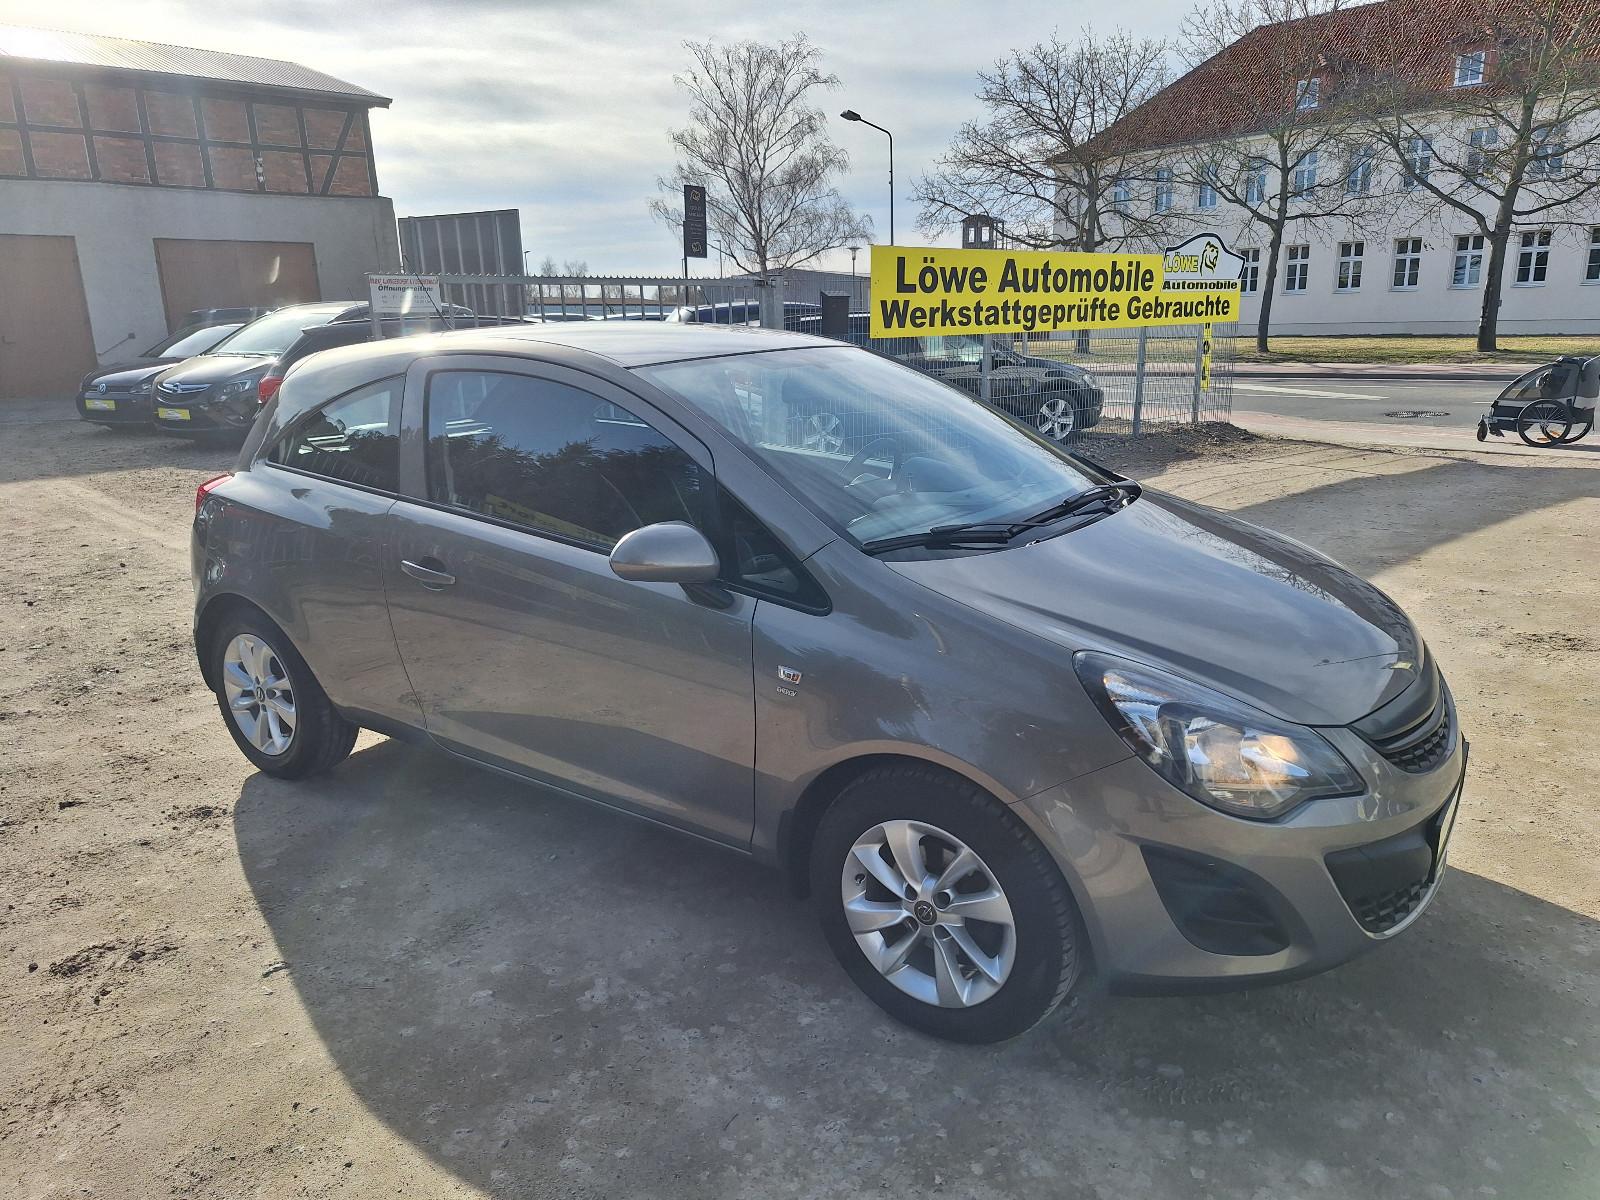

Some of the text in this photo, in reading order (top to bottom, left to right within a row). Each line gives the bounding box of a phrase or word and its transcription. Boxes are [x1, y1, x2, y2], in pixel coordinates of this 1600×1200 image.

[896, 256, 1154, 294] Löwe Automobile
[1164, 252, 1199, 273] LÖWE
[1163, 280, 1238, 290] Automobile
[880, 295, 1230, 331] Werkstattgeprüfte Gebrauchte
